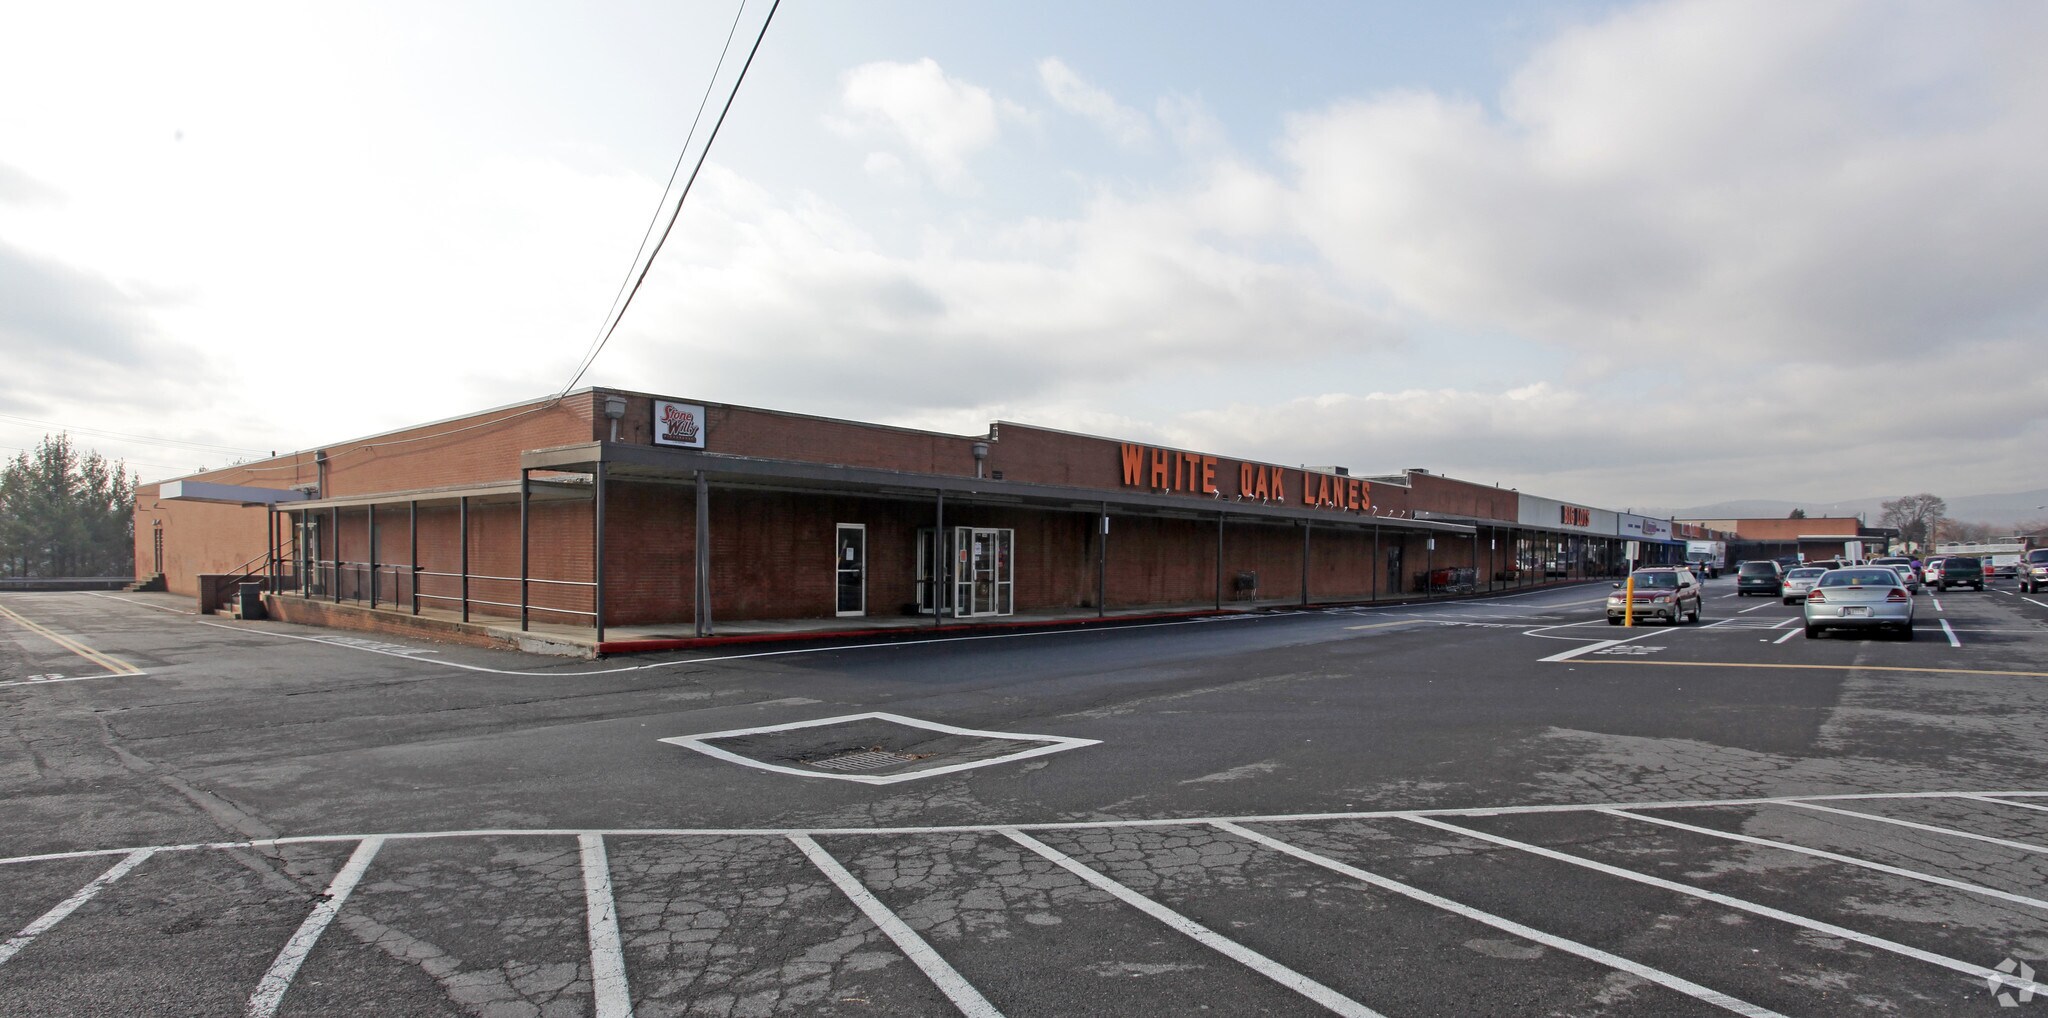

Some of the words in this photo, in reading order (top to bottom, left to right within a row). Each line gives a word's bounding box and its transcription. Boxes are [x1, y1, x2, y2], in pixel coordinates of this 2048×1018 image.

[660, 404, 693, 423] Stone
[1121, 443, 1218, 493] WHITE
[1241, 462, 1285, 500] OAK
[1304, 472, 1371, 511] LANES
[1562, 505, 1575, 524] BIG
[1576, 508, 1590, 527] LOTS
